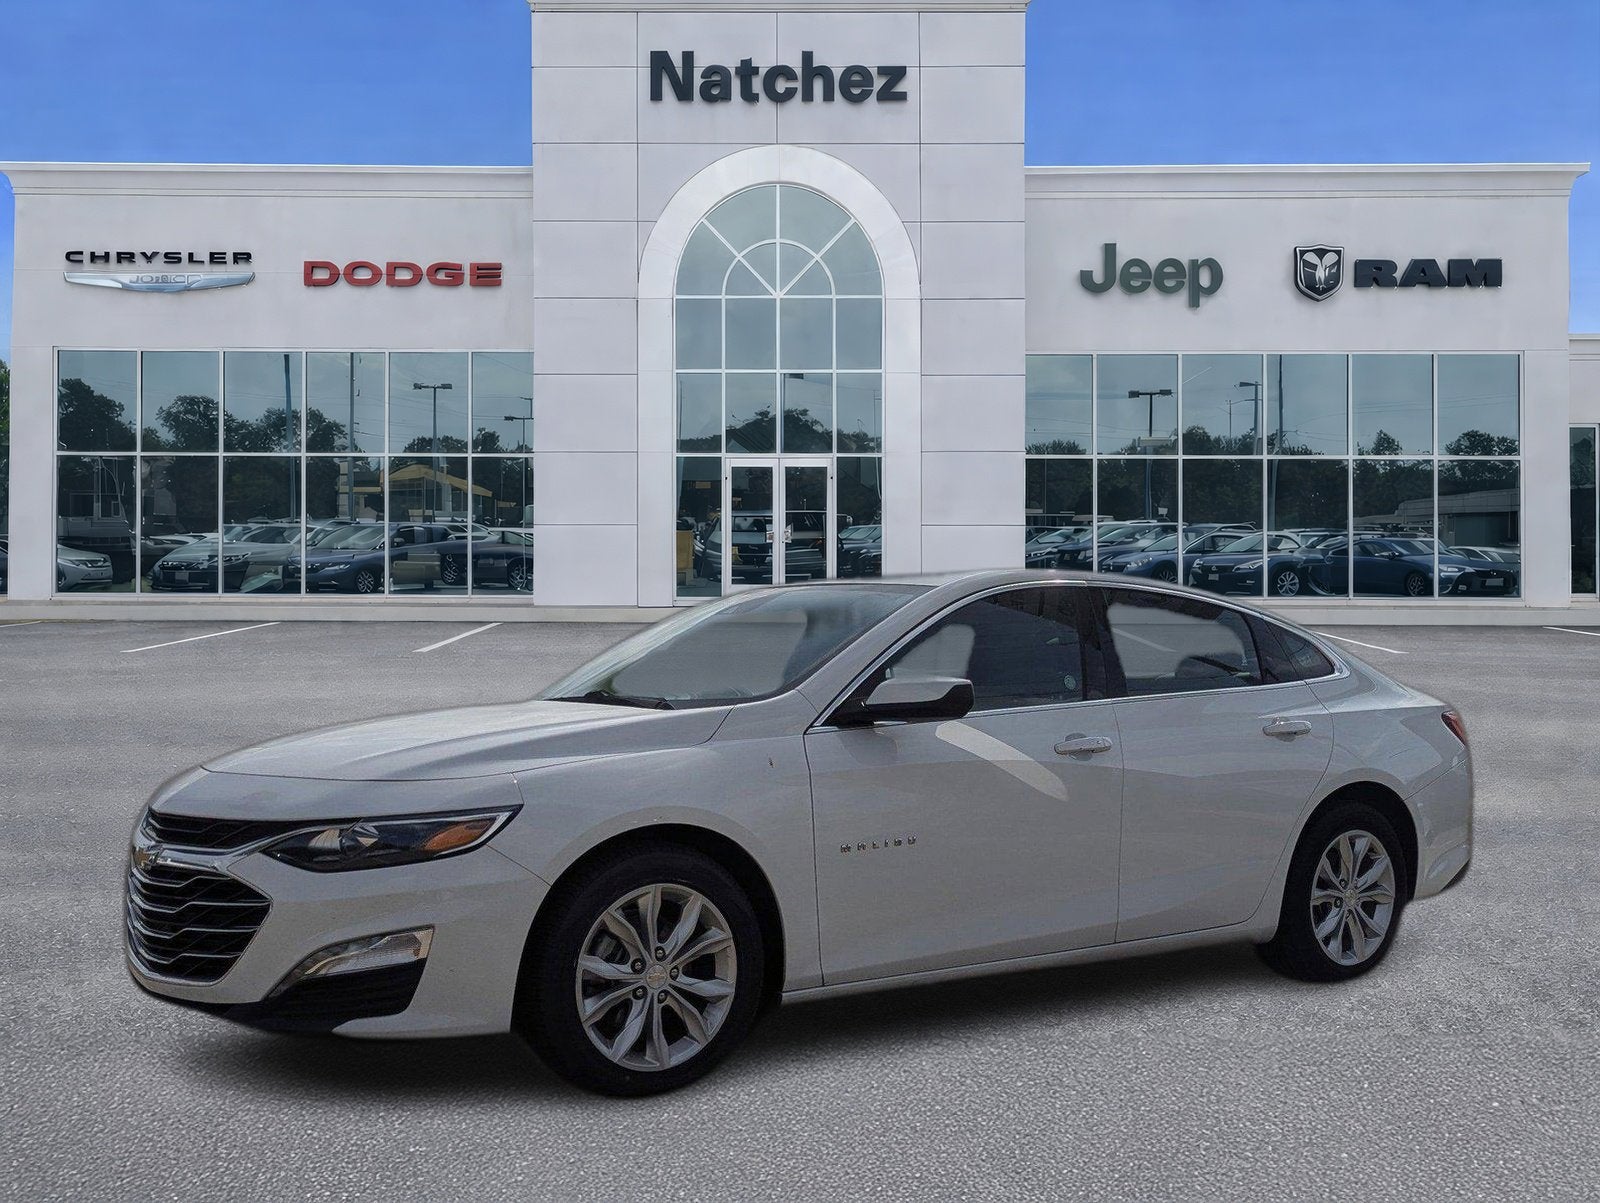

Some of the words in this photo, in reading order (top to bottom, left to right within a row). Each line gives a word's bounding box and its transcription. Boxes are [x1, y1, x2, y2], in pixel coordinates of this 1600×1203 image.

[650, 50, 908, 103] Natchez
[65, 251, 253, 265] CHRYSLER
[304, 261, 502, 287] DODGE
[1080, 243, 1224, 308] Jeep
[1354, 259, 1503, 288] RAM
[840, 836, 917, 853] MALIBU
